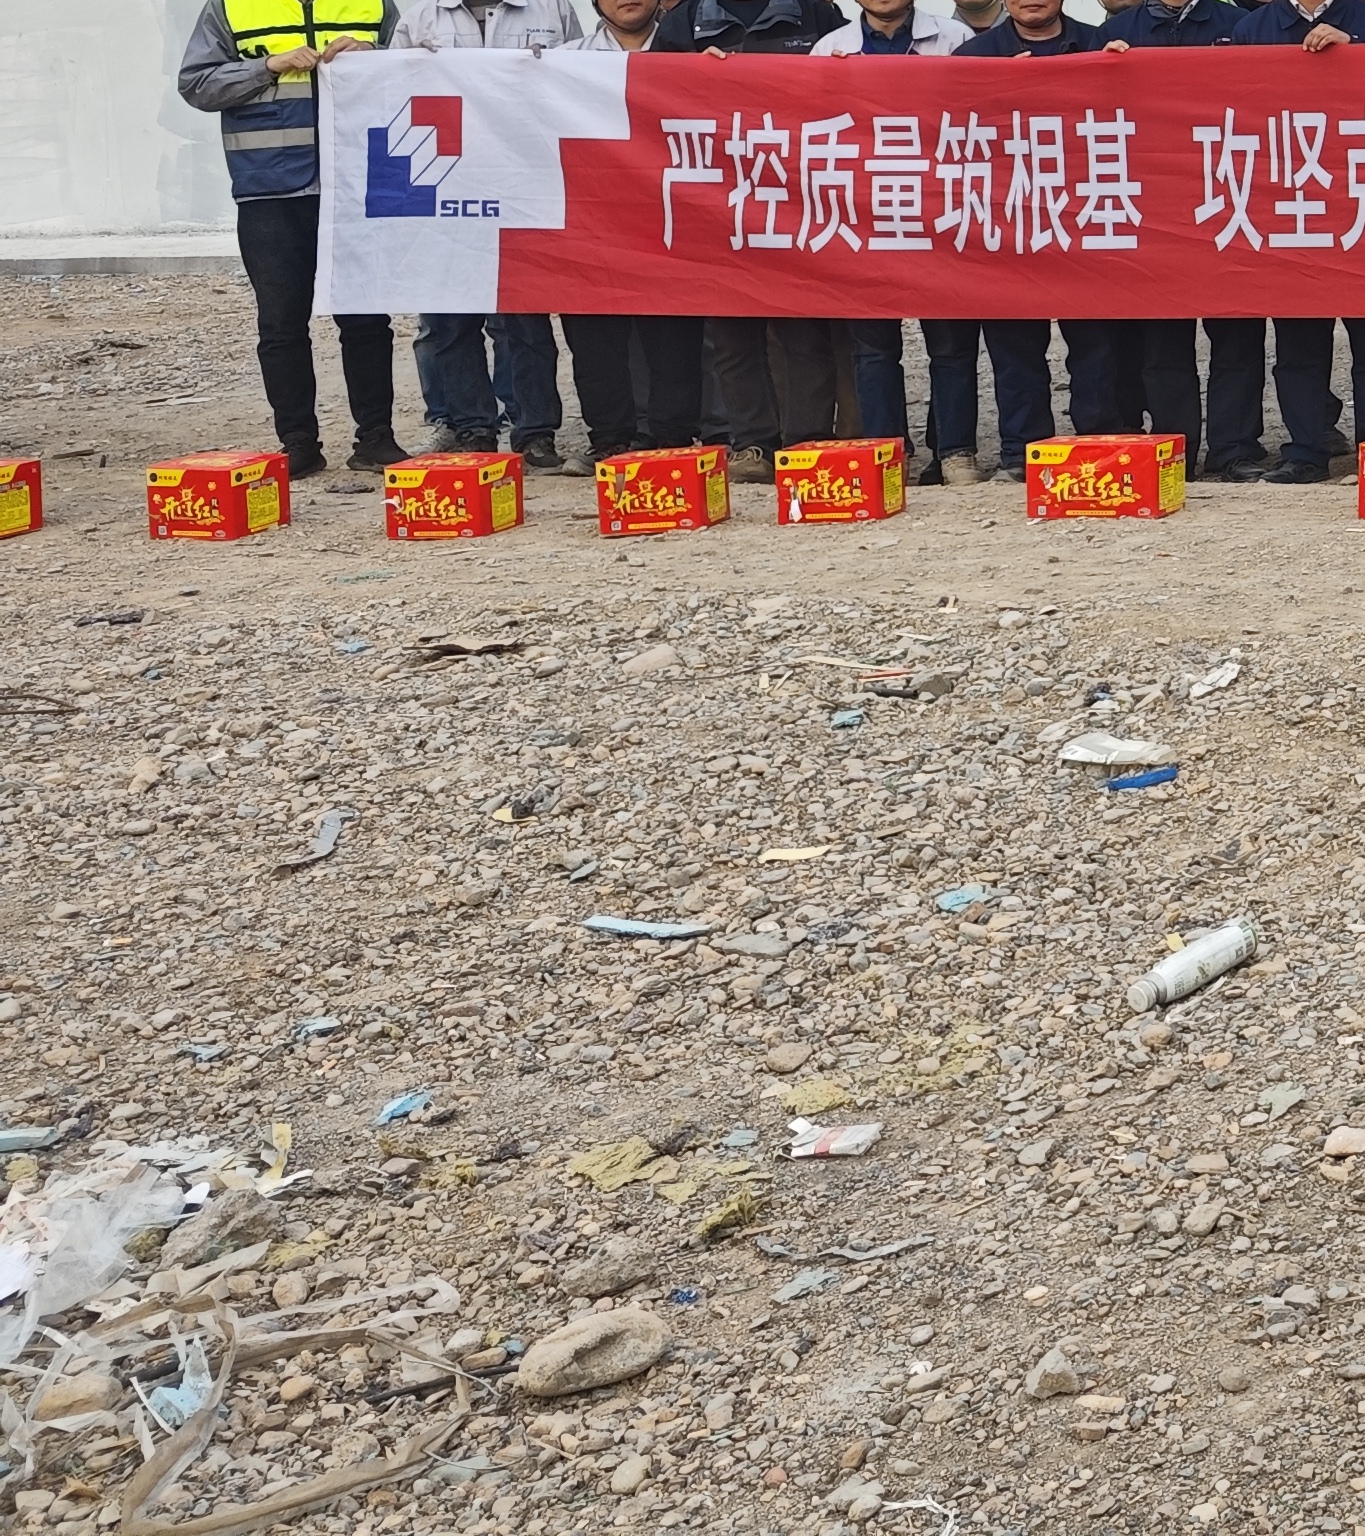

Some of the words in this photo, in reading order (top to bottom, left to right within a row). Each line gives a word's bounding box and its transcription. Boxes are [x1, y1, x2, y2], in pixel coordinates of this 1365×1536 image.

[660, 108, 1144, 254] 严控质量筑根基
[440, 199, 500, 217] SCG
[1050, 463, 1124, 502] 开门红
